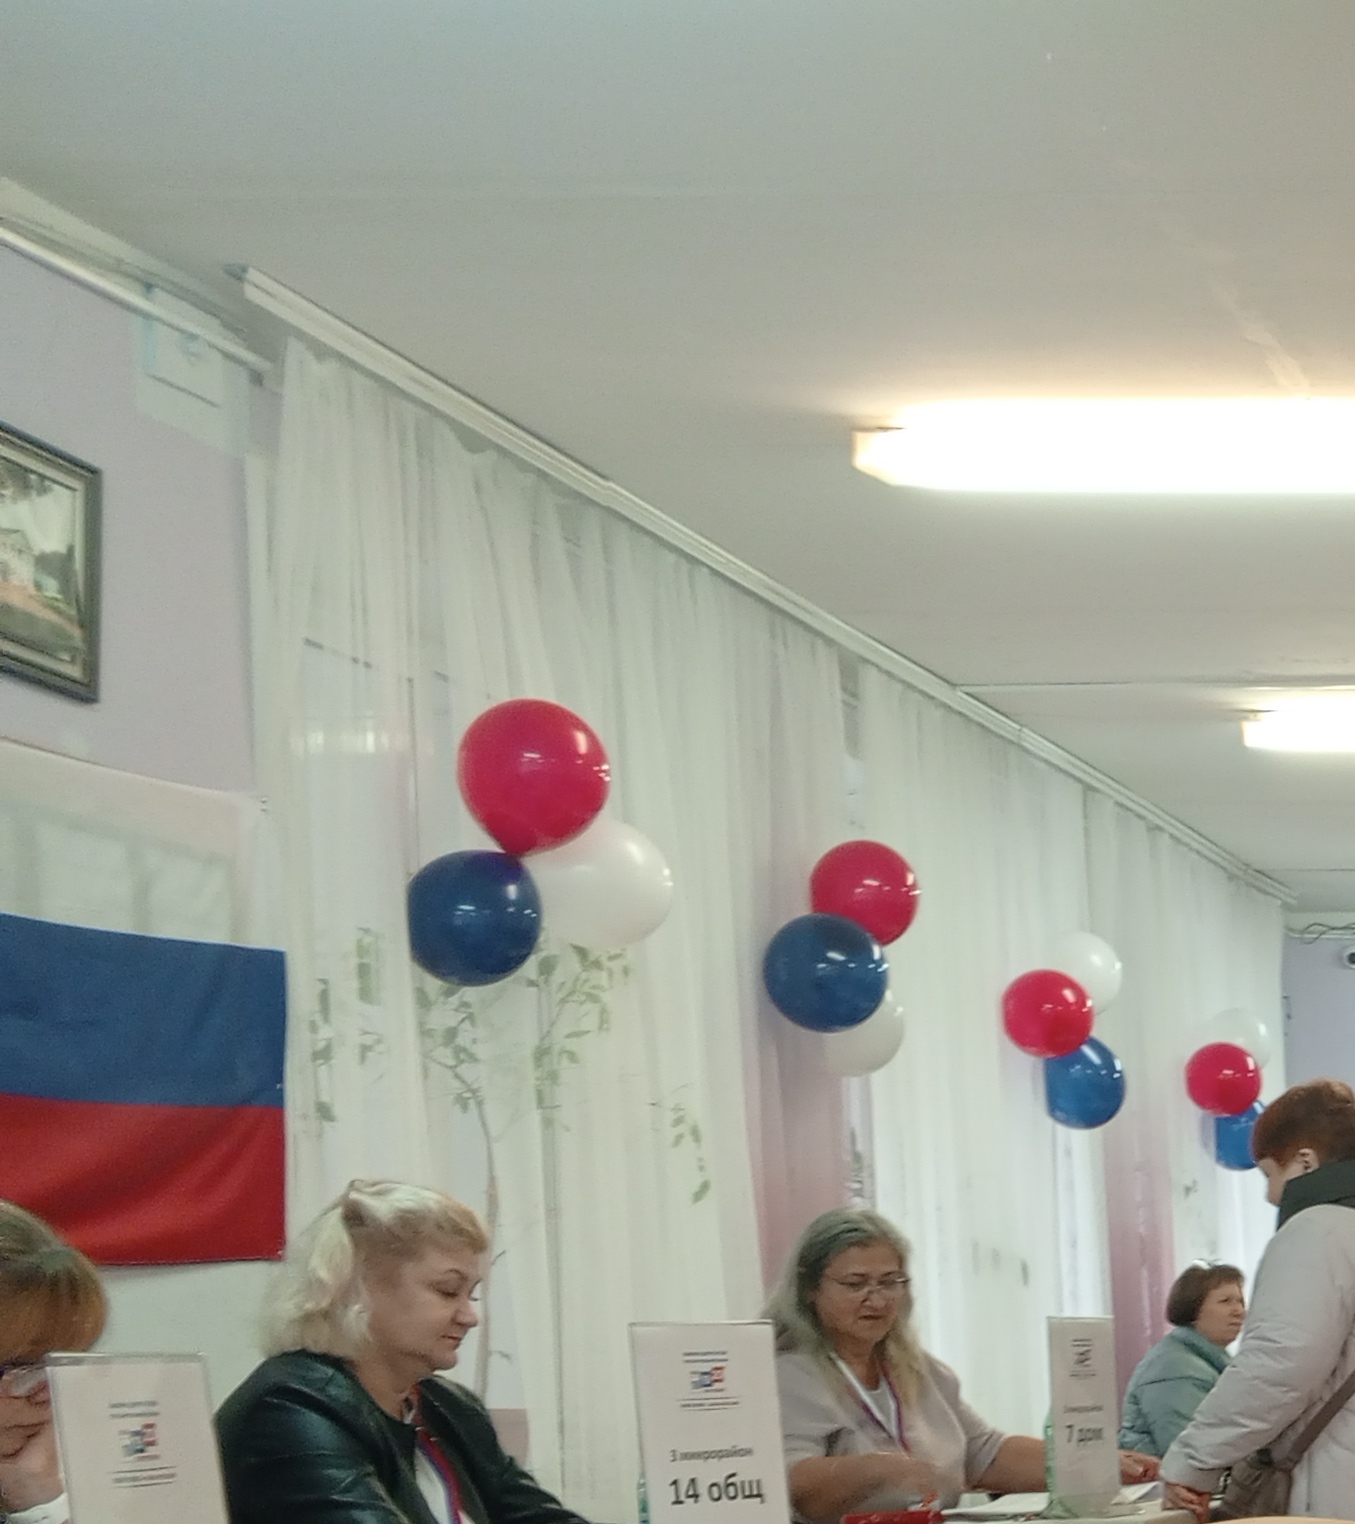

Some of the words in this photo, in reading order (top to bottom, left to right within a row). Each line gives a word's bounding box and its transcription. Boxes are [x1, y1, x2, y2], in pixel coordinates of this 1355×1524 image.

[1065, 1424, 1074, 1443] 7
[669, 1450, 677, 1462] 3
[679, 1445, 753, 1461] микрорайон
[669, 1477, 700, 1505] 14
[708, 1472, 765, 1504] общ
